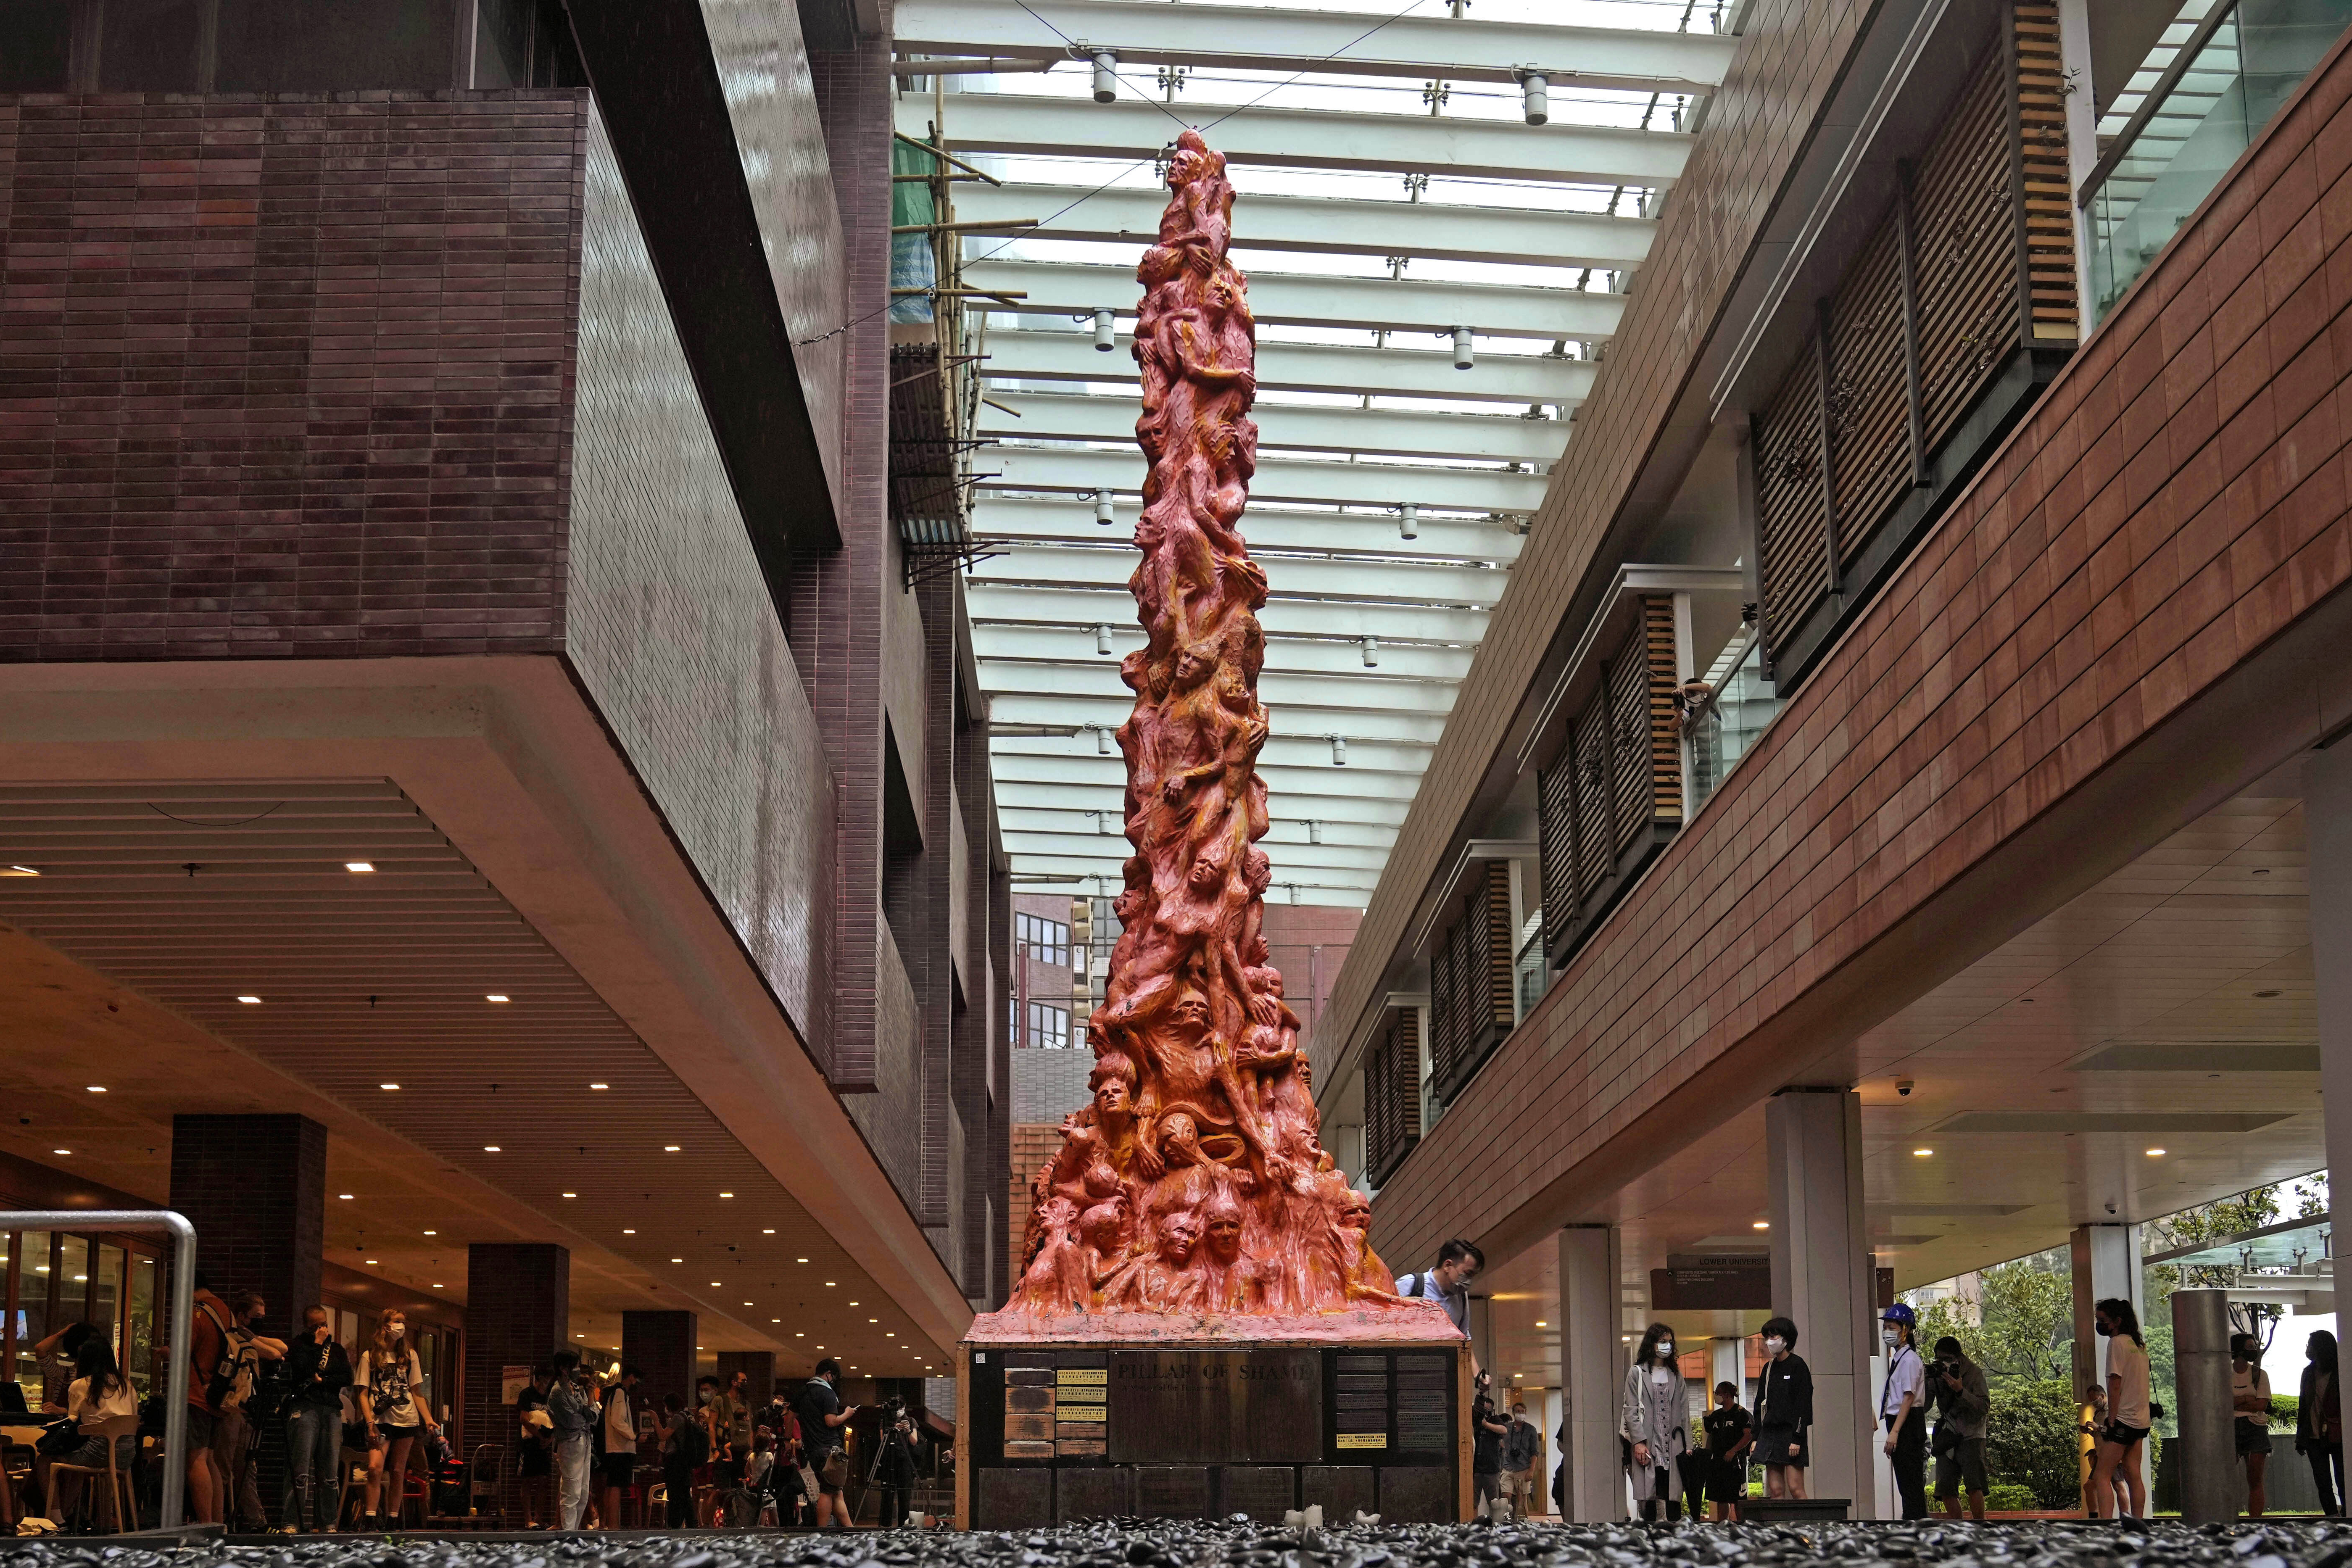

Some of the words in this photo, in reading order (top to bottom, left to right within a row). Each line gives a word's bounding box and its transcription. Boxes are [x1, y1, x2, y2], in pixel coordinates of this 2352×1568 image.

[1118, 1364, 1191, 1379] PILLAR
[1203, 1364, 1230, 1379] OF
[1239, 1364, 1313, 1380] SHAME
